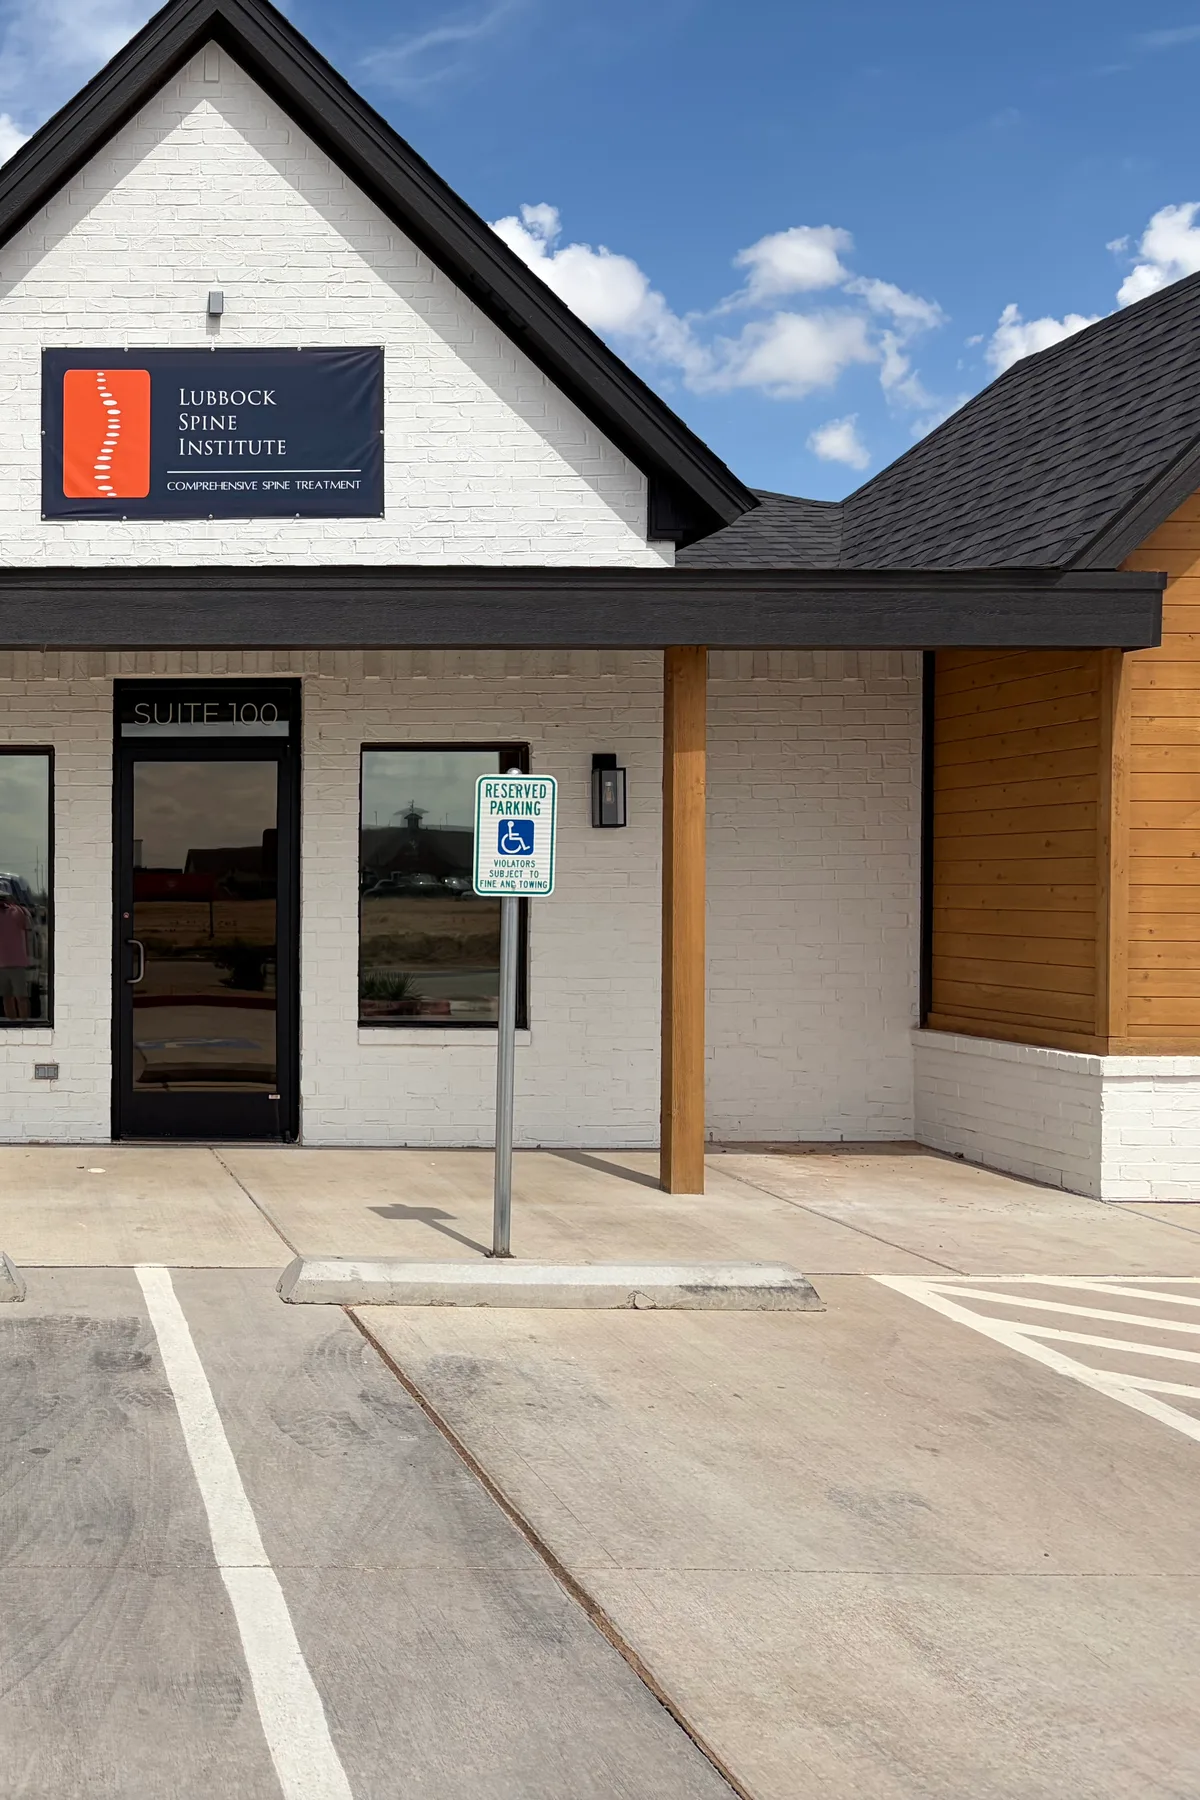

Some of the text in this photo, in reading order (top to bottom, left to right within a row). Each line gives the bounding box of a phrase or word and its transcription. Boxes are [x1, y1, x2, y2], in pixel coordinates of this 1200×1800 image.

[178, 388, 277, 407] LUBBOCK
[178, 413, 238, 431] SPINE
[178, 438, 287, 456] INSTITUTE
[166, 479, 362, 491] COMPREHENSIVE SPINE TREATMENT
[133, 702, 278, 726] SUITE 100
[485, 783, 547, 799] RESERVED
[490, 800, 541, 816] PARKING
[493, 859, 536, 868] VIOLATORS
[489, 870, 539, 878] SUBJECT TO
[480, 880, 548, 889] FINE AND TOWING
